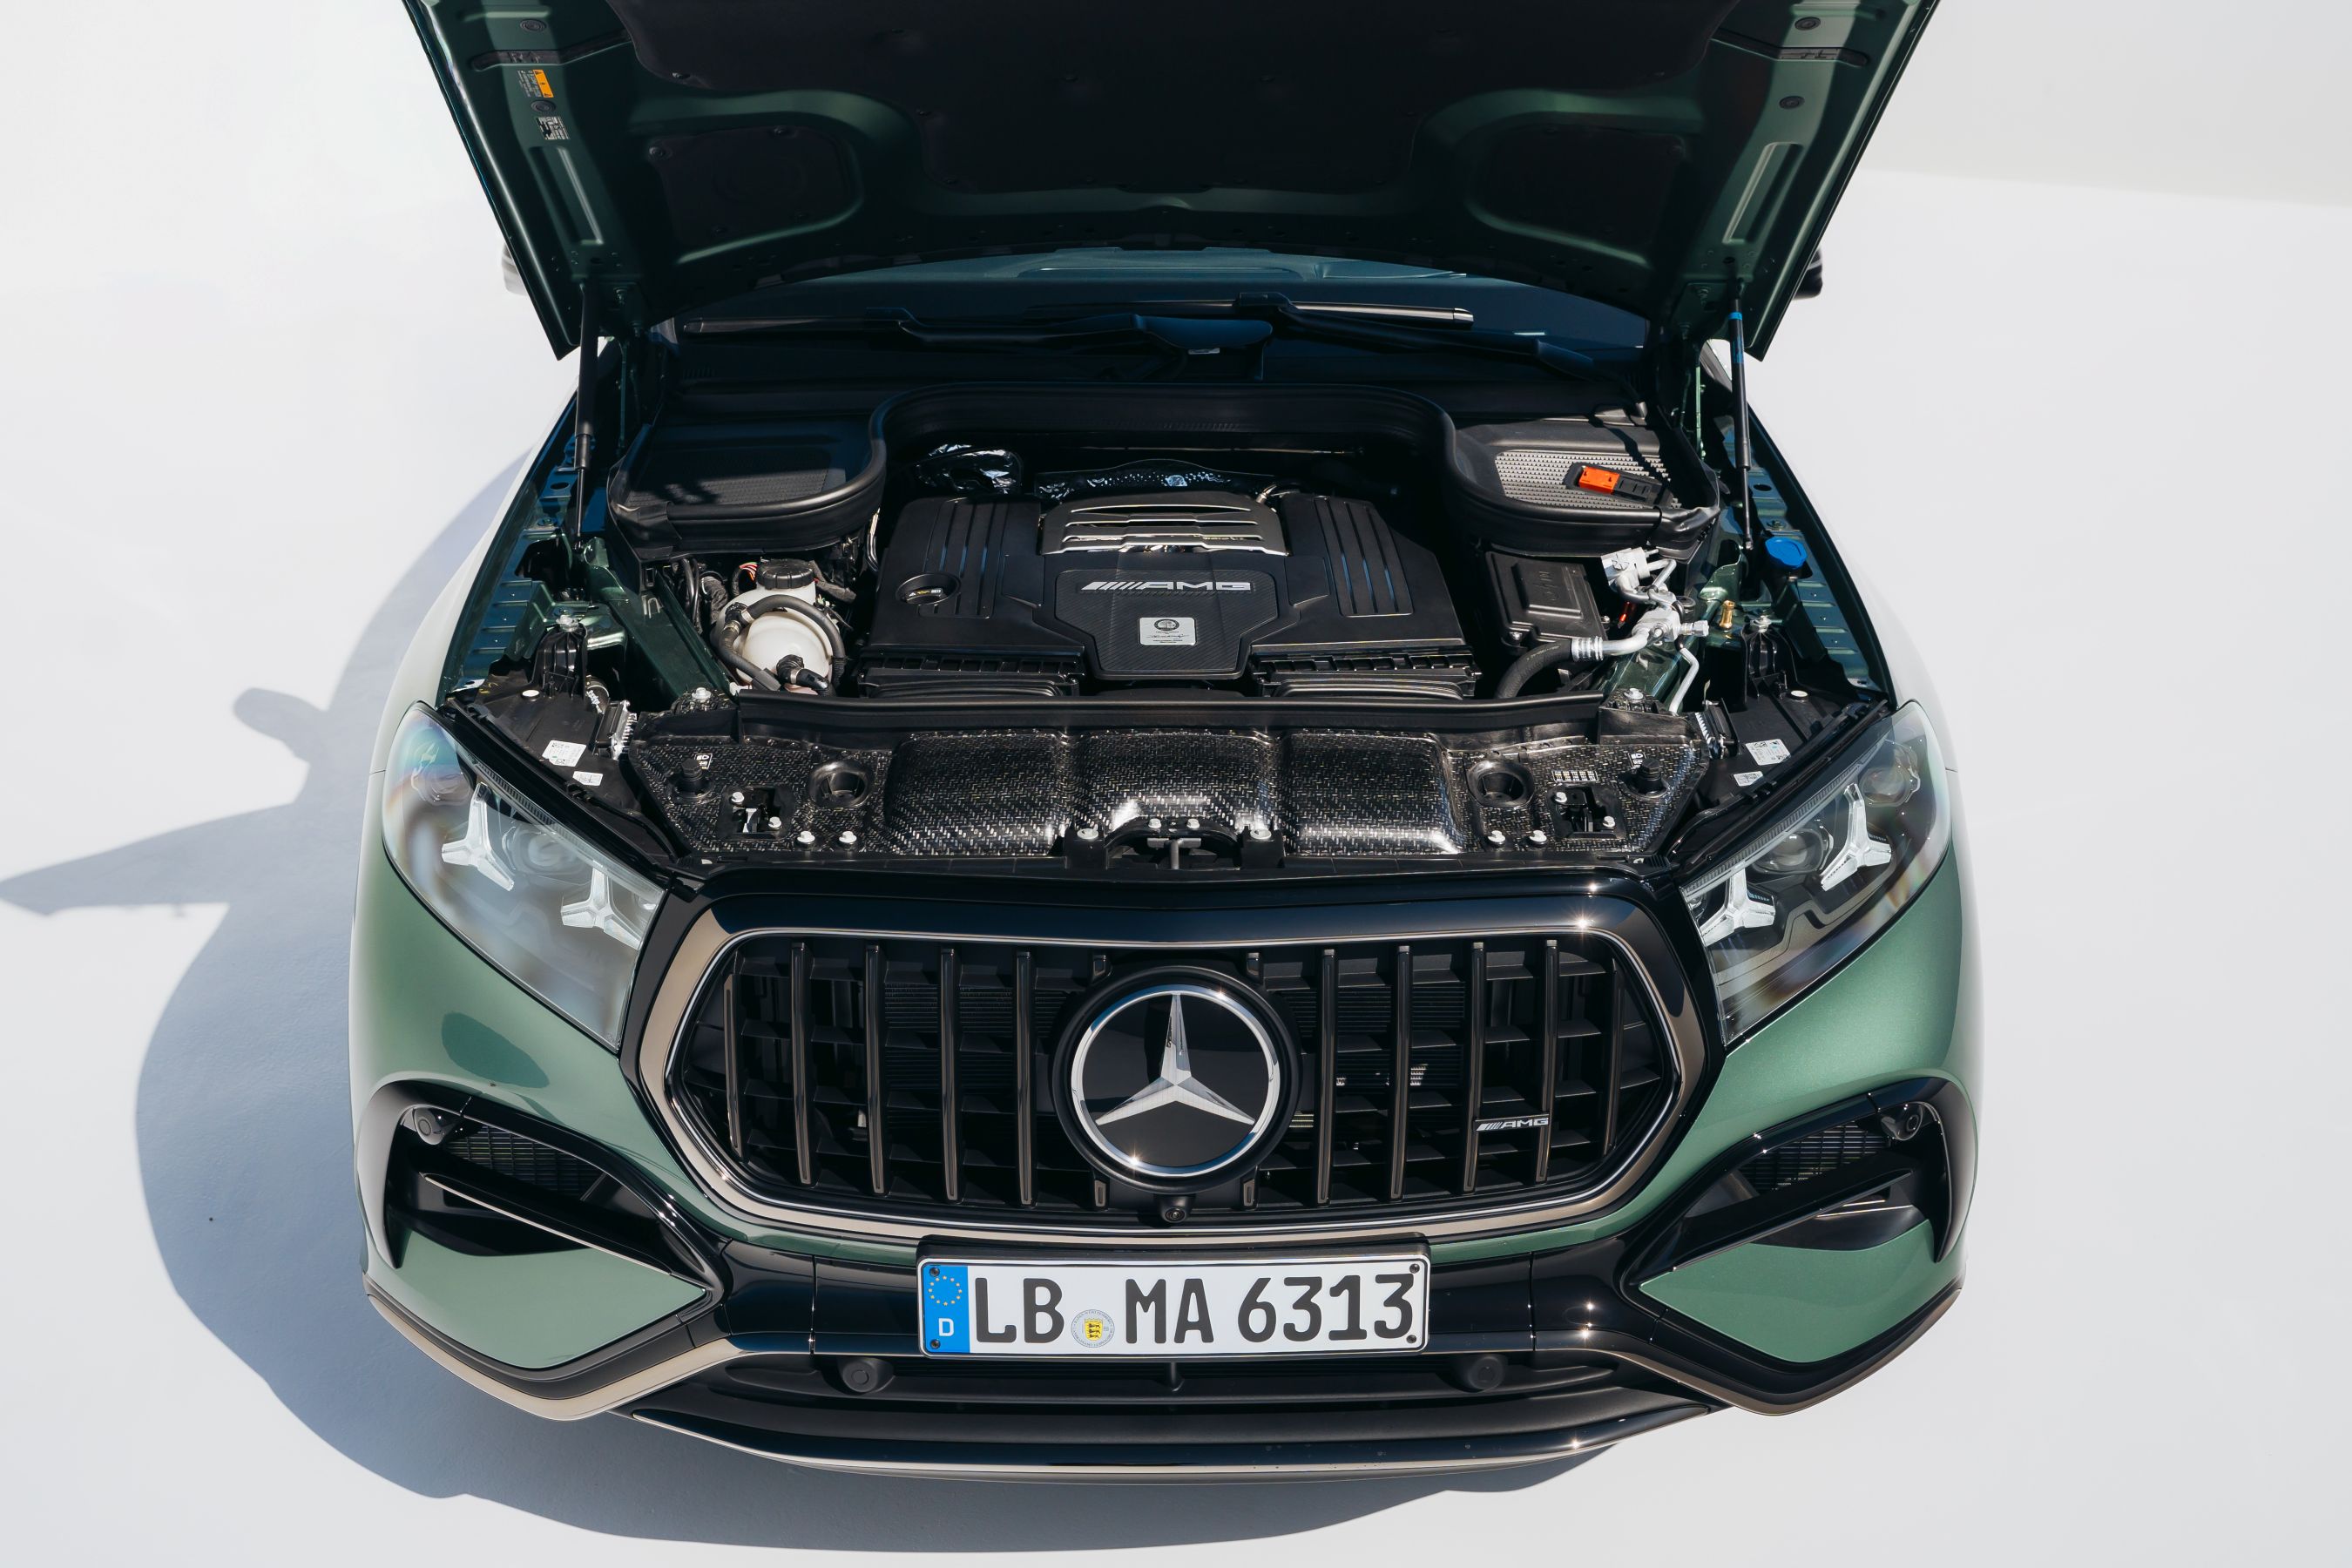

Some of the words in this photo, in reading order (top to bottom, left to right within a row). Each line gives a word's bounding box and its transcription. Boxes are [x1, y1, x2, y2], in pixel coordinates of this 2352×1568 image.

[938, 1317, 955, 1337] D
[975, 1277, 1064, 1344] LB
[1125, 1277, 1214, 1344] MA
[1237, 1273, 1415, 1343] 6313
